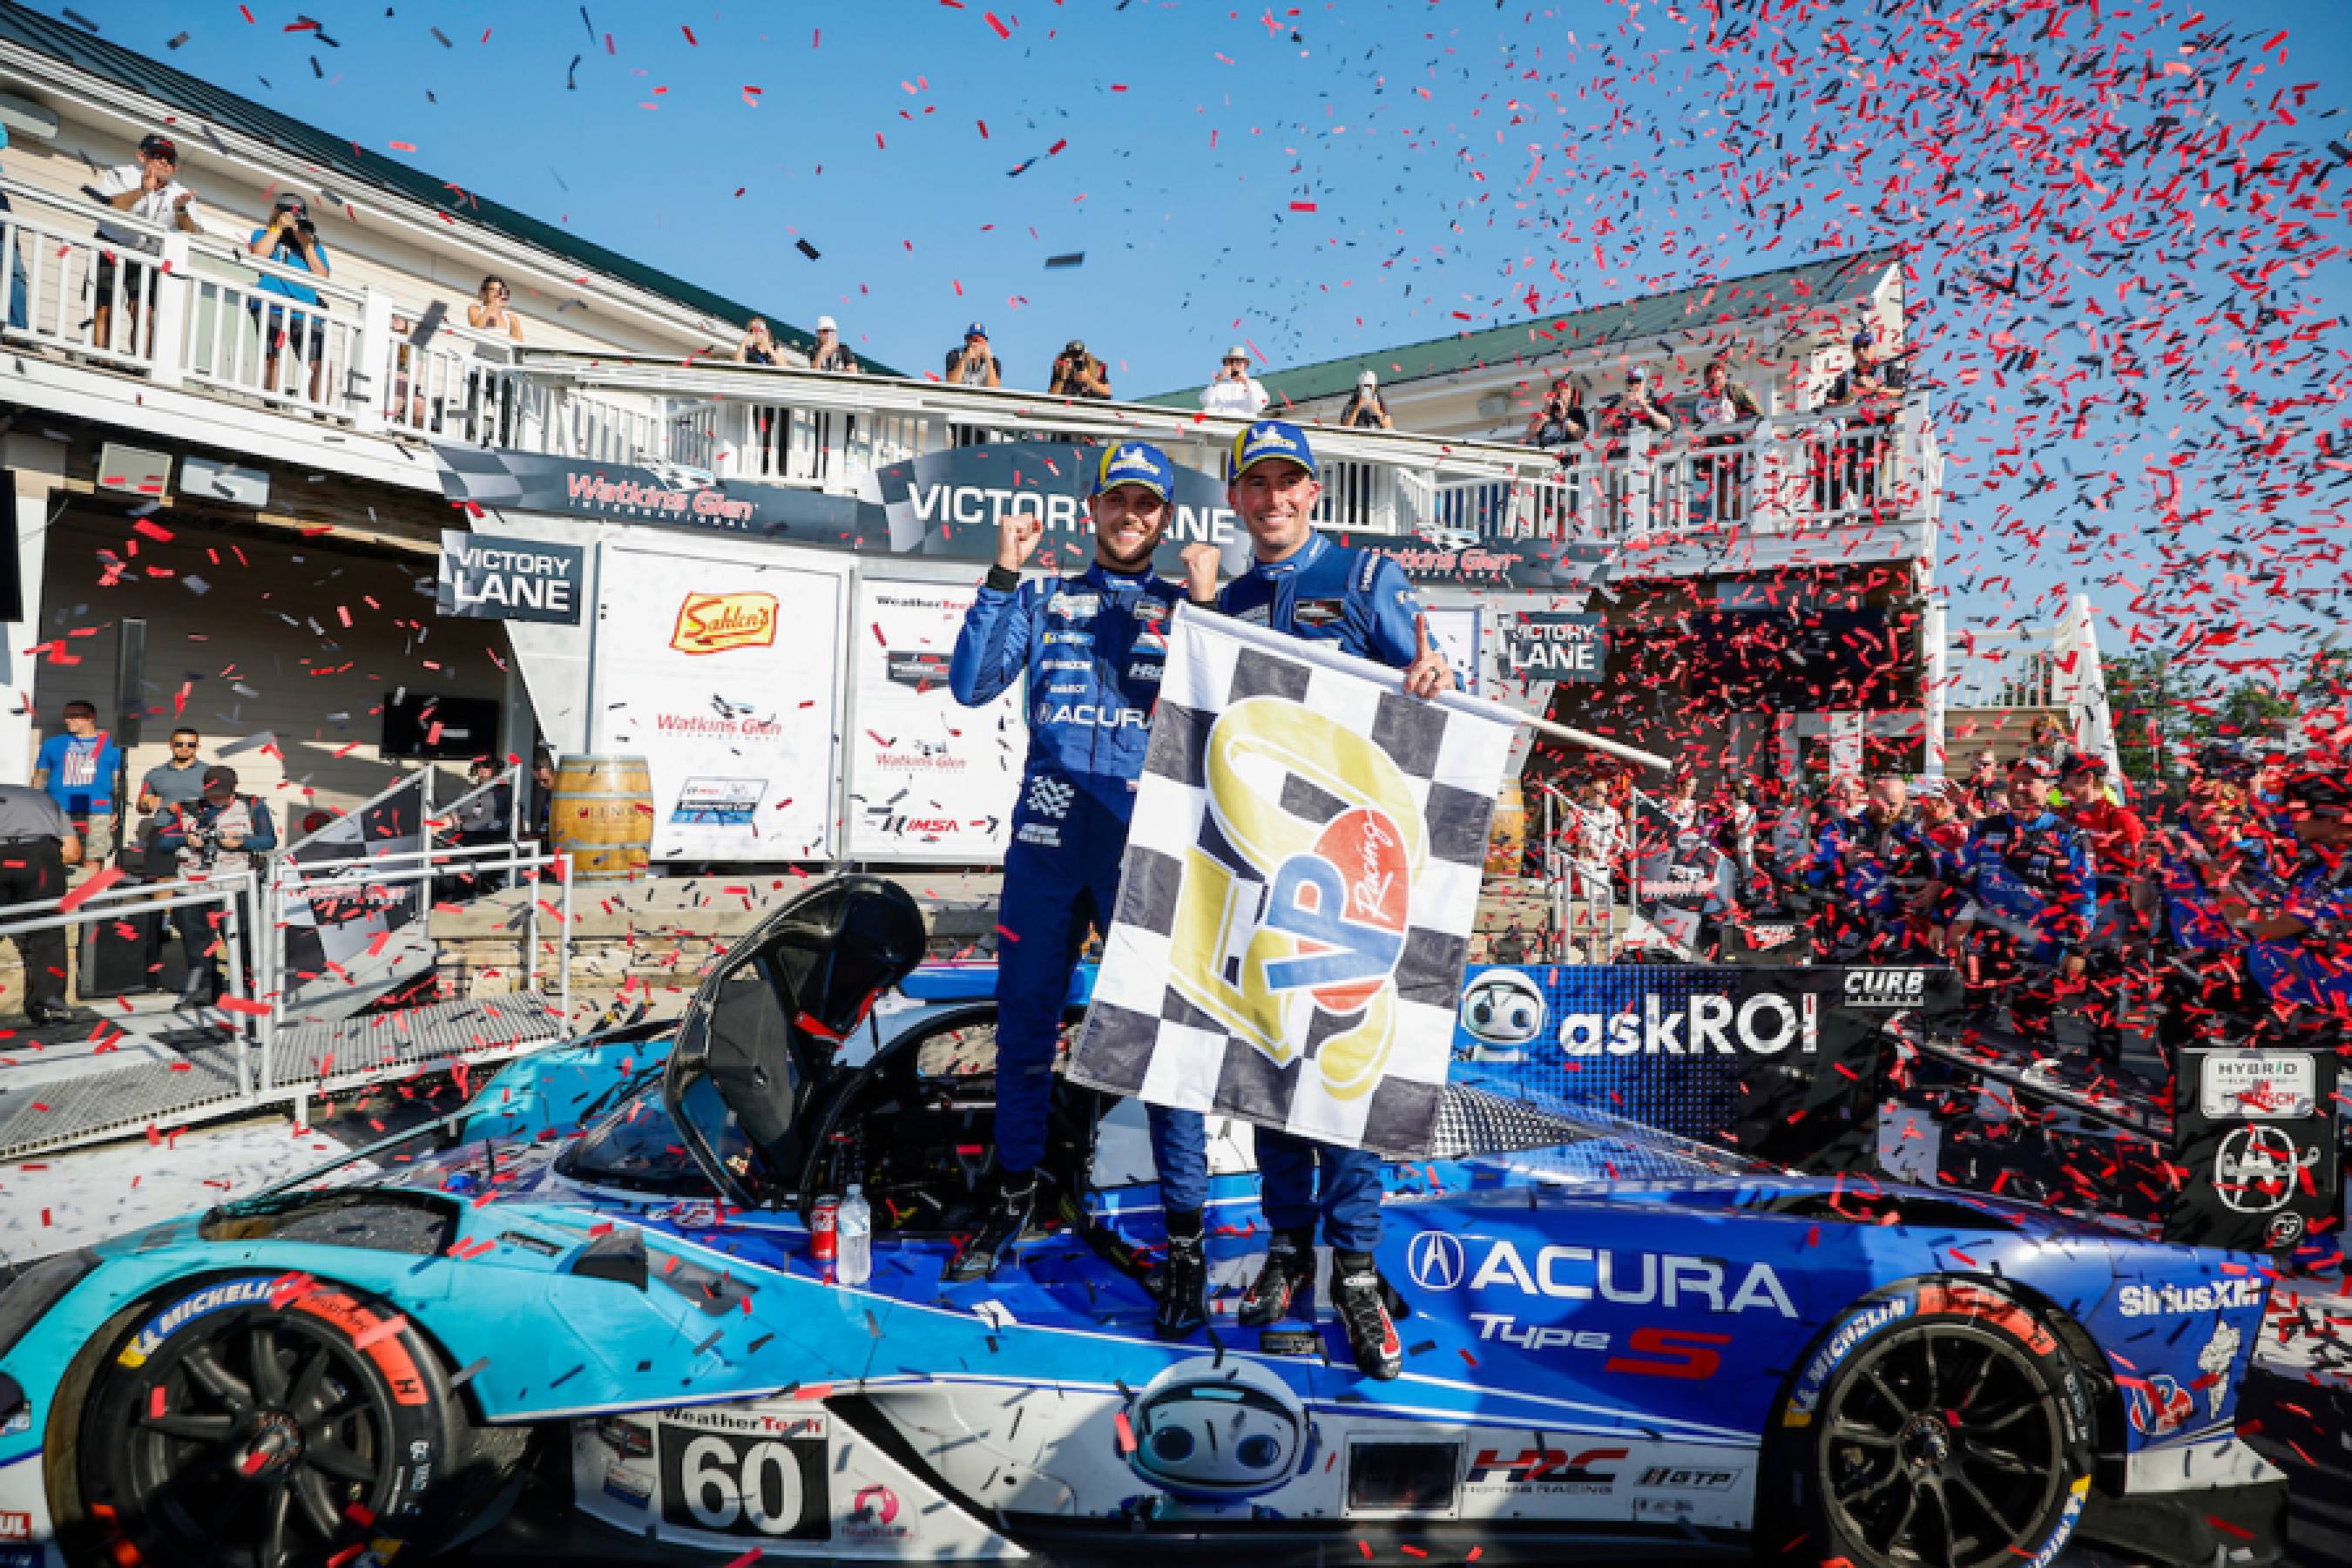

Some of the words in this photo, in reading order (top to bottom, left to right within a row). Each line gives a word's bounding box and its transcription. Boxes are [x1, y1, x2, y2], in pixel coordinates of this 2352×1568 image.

[568, 473, 688, 510] Watkins
[693, 490, 754, 520] Glen
[1162, 504, 1236, 544] NE
[456, 548, 571, 578] VICTORY
[454, 569, 571, 612] LANE
[1511, 623, 1596, 643] VICTORY
[1510, 641, 1596, 670] LANE
[1354, 807, 1395, 923] Racing
[1264, 853, 1404, 991] VP
[1843, 970, 1925, 996] CURB
[1559, 991, 1817, 1058] askROI
[1470, 1240, 1799, 1318] ACURA
[2119, 1278, 2262, 1317] SiriusXM
[1604, 1327, 1733, 1381] S
[683, 1436, 803, 1535] 60
[1465, 1448, 1631, 1484] HRC
